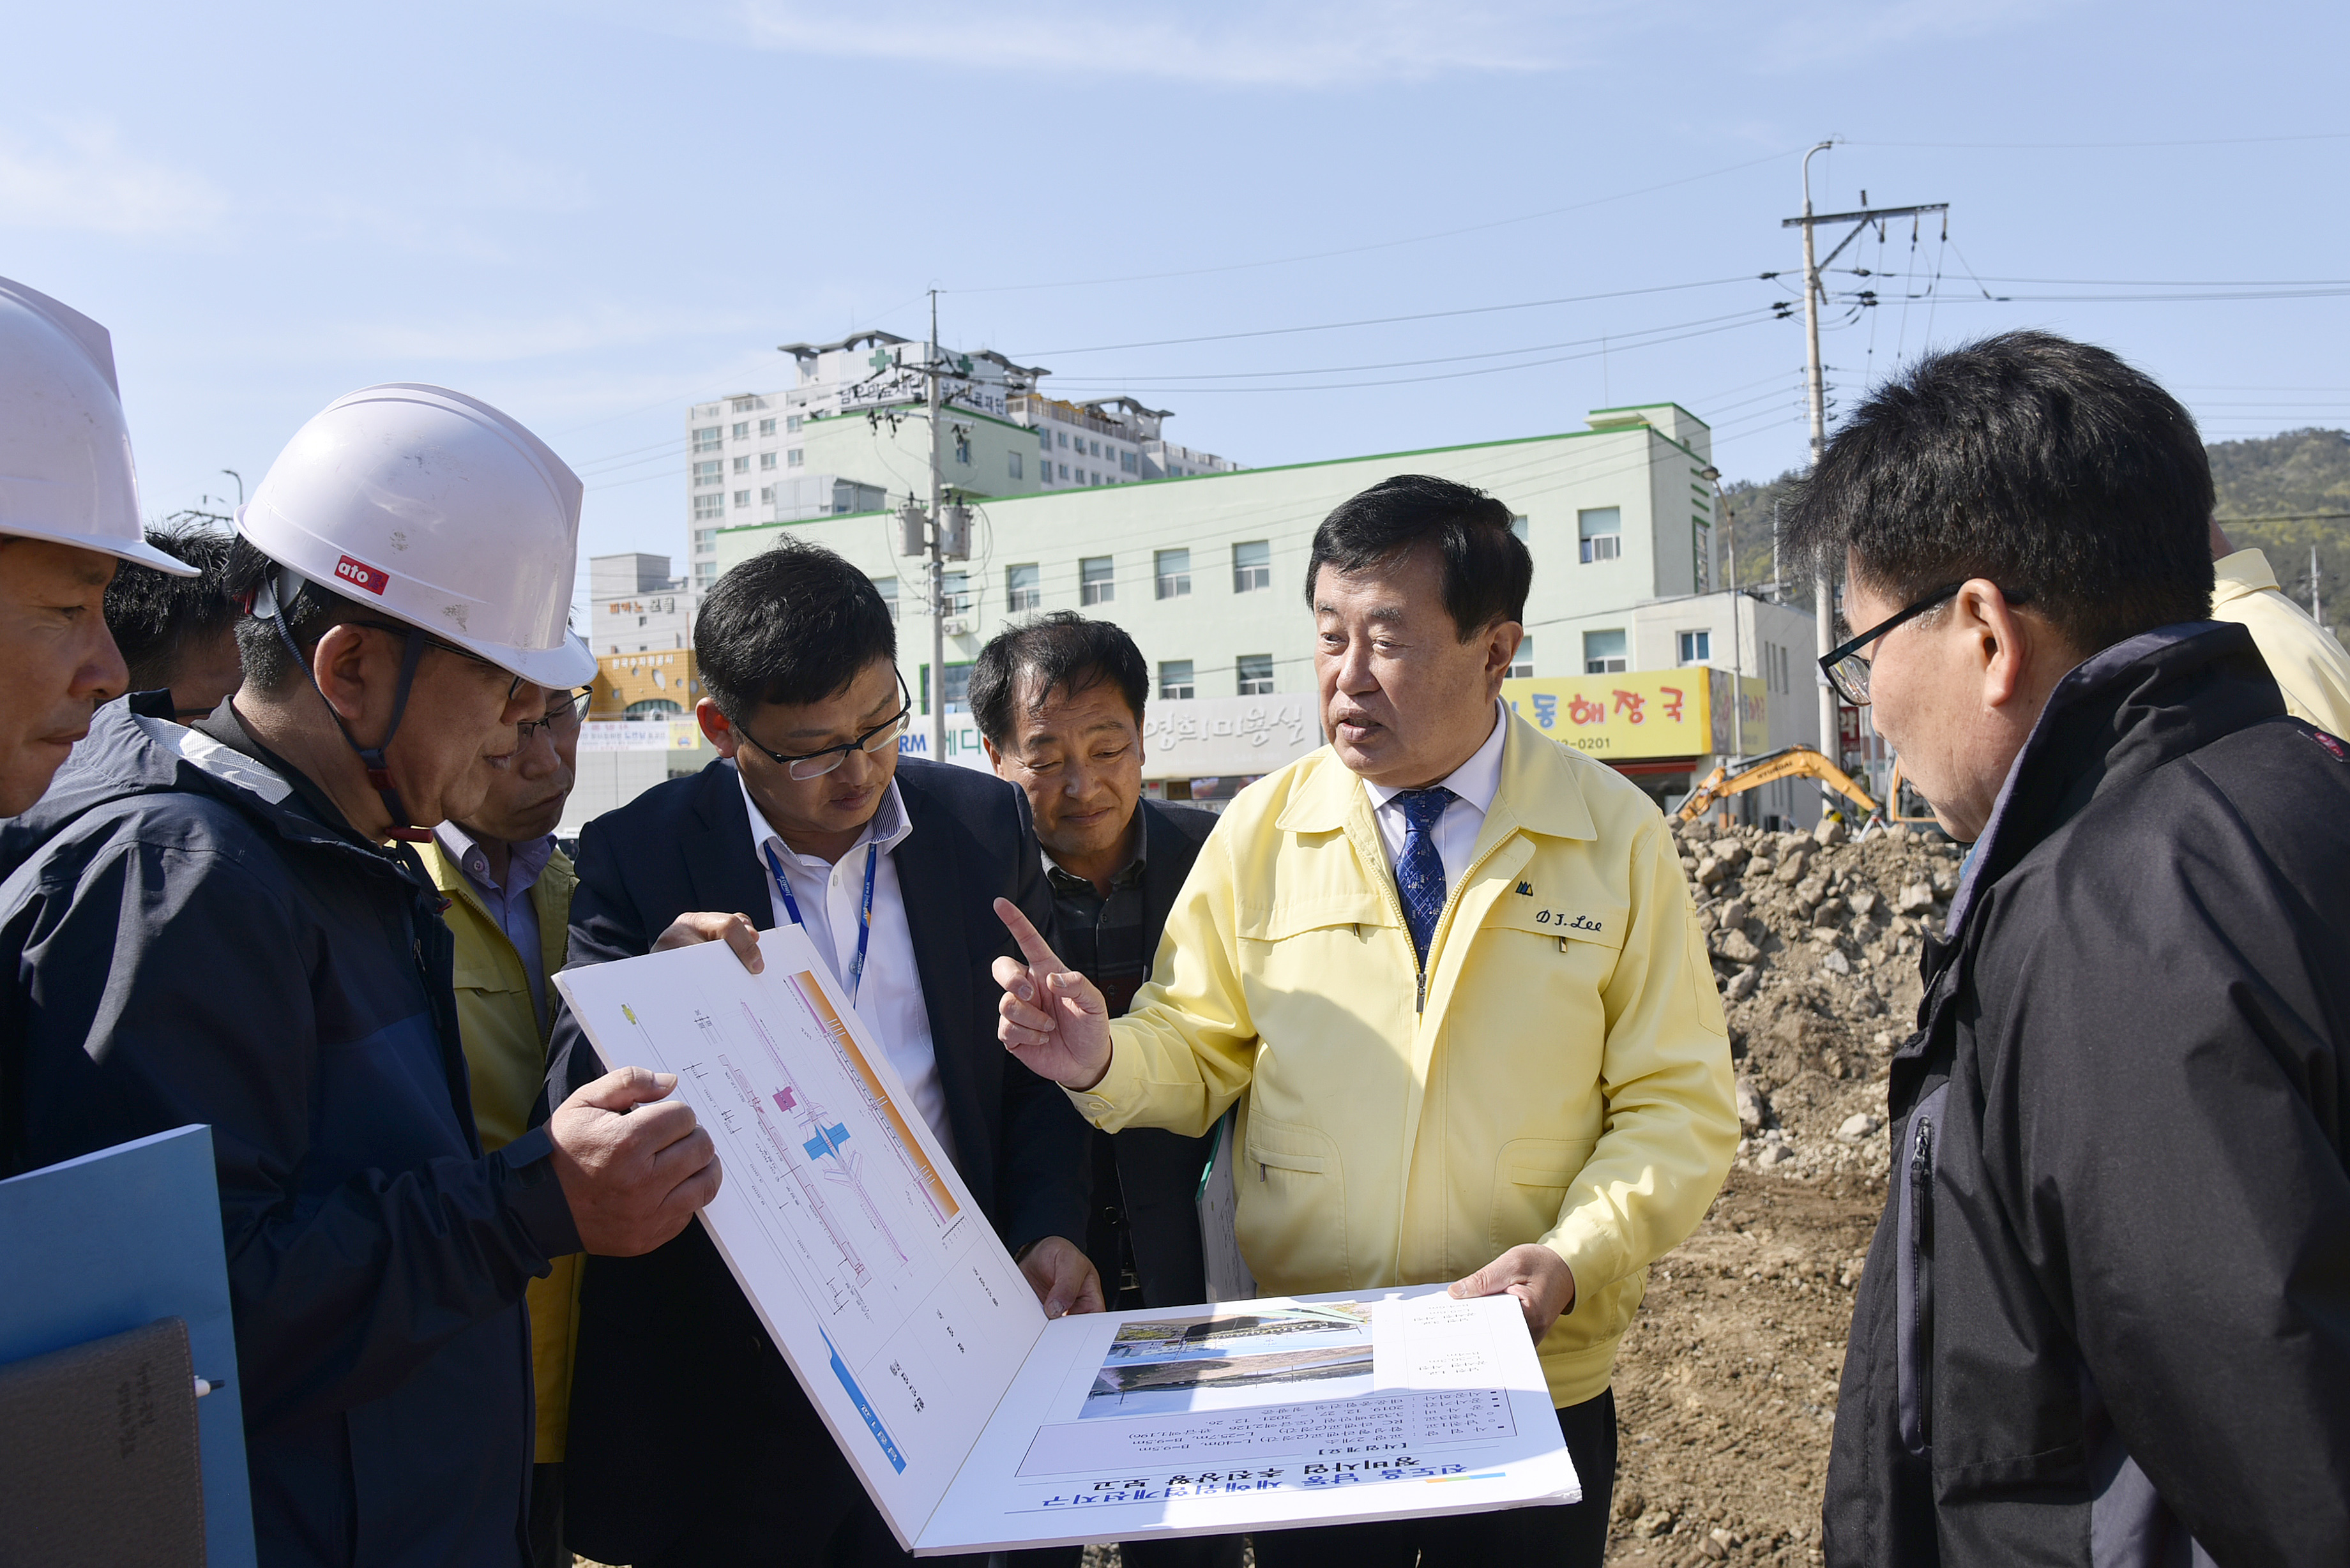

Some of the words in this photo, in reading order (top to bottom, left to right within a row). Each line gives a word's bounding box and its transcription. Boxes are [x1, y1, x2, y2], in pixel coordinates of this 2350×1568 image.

[338, 562, 368, 584] ato
[609, 601, 644, 614] 피아노
[649, 596, 674, 614] 모텔
[1511, 687, 1685, 730] 동해장국
[1143, 704, 1305, 751] 영희미용실
[1423, 1397, 1482, 1407] 공사기간
[1131, 1437, 1183, 1445] B=9.5m
[1137, 1444, 1189, 1452] B=9.5m
[1303, 1455, 1420, 1474] 정비사업
[1378, 1463, 1467, 1481] 진도읍
[1090, 1477, 1150, 1491] 보고
[1164, 1466, 1284, 1485] 추진상황
[1300, 1472, 1360, 1486] 남동
[1038, 1479, 1283, 1507] 재해위험개선지구
